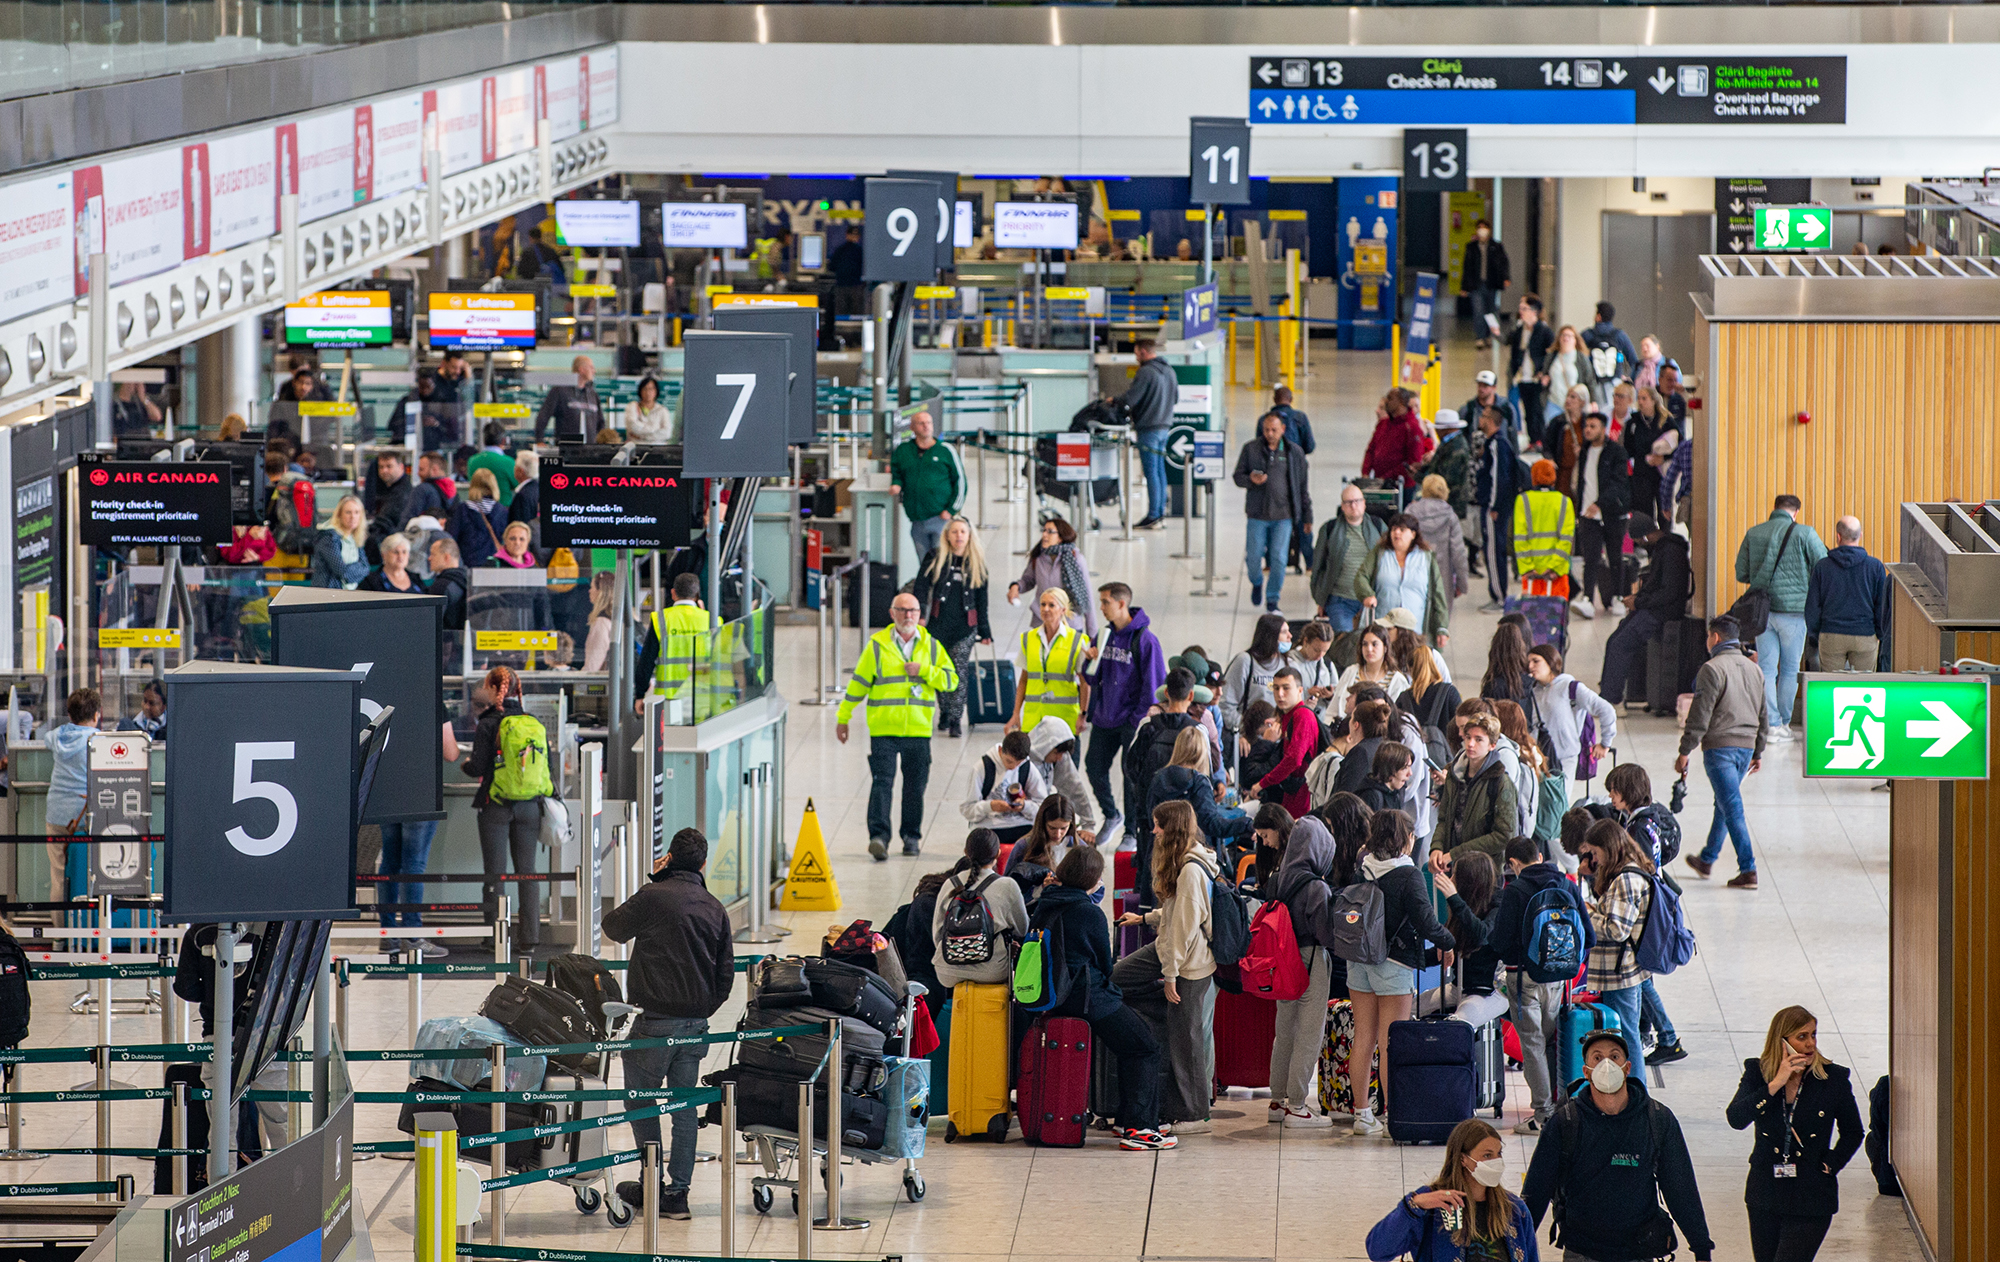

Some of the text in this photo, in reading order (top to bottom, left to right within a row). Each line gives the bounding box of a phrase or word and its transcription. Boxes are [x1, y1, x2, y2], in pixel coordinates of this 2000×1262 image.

[1423, 58, 1462, 74] Clárú
[1313, 61, 1343, 85] 13
[1540, 61, 1571, 85] 14
[1387, 74, 1497, 90] Check-in Areas
[1776, 78, 1802, 88] Area
[1804, 77, 1819, 88] 14
[1714, 91, 1820, 106] Oversized Baggage
[1714, 104, 1807, 116] Check in Area 14
[1202, 144, 1239, 184] 11
[1411, 141, 1459, 179] 13
[1003, 208, 1070, 218] FINNAIR
[886, 207, 918, 256] 9
[1003, 221, 1045, 231] PRIORITY
[322, 295, 371, 307] Lufthansa
[467, 297, 515, 309] Lufthansa
[307, 328, 372, 340] Economy Class
[715, 373, 756, 440] 7
[114, 472, 219, 484] AIR CANADA
[574, 476, 677, 488] AIR CANADA
[91, 500, 164, 511] Priority check-in
[551, 503, 623, 515] Priority check-in
[91, 511, 199, 523] Enregistrement prioritaire
[552, 514, 657, 526] Enregistrement prioritaire
[111, 535, 201, 543] STAR ALLIANCE GOLD
[591, 538, 627, 546] ALLIANCE
[225, 741, 298, 856] 5
[128, 969, 160, 977] DublinAirport
[675, 1036, 703, 1047] DublinAirport
[745, 1030, 773, 1041] DublinAirport
[531, 1046, 560, 1057] DublinAirport
[603, 1041, 631, 1052] DublinAirport
[131, 1053, 164, 1061] DublinAirport
[66, 1093, 100, 1101] DublinAirport
[426, 1094, 461, 1102] DublinAirport
[533, 1092, 567, 1101] DublinAirport
[638, 1089, 673, 1099] DublinAirport
[666, 1100, 688, 1113] DublinAirport
[604, 1114, 625, 1125] DublinAirport
[541, 1125, 562, 1137] DublinAirport
[476, 1135, 497, 1146] DublinAirport
[555, 1166, 577, 1178] DublinAirport
[20, 1186, 58, 1194] DublinAirport
[488, 1179, 510, 1191] DublinAirport
[223, 1187, 228, 1202] 2
[227, 1183, 240, 1200] Nasc
[198, 1204, 234, 1238] Terminal 2 Link
[549, 1252, 586, 1261] DublinAirport
